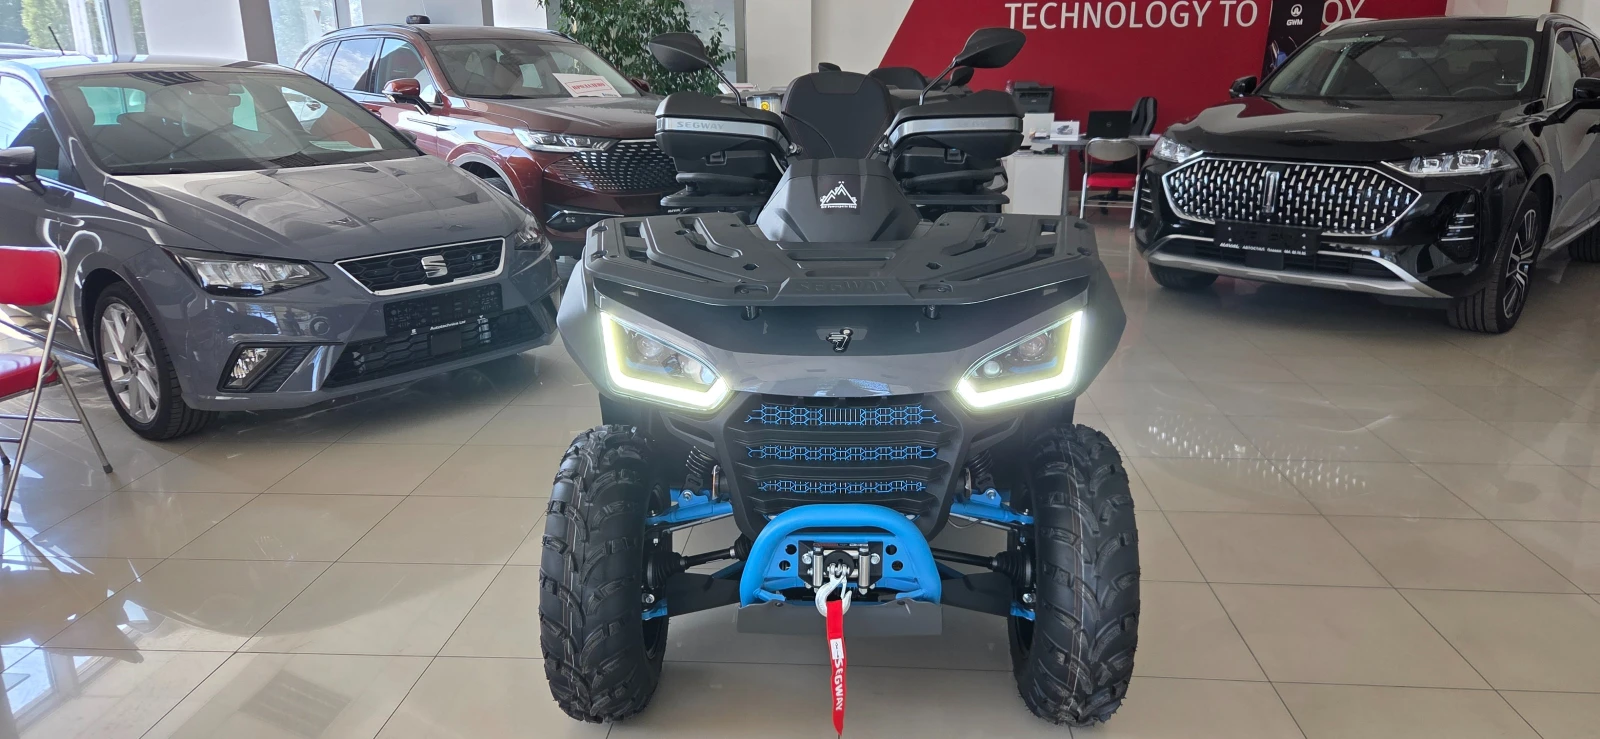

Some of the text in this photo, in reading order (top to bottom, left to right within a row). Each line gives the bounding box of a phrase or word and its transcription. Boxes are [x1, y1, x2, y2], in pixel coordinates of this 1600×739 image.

[1004, 0, 1212, 30] TECHNOLOGY
[1219, 0, 1258, 28] TO
[1286, 18, 1304, 27] GWM
[676, 121, 725, 131] SEGWAY
[834, 658, 844, 711] SEGWAY
